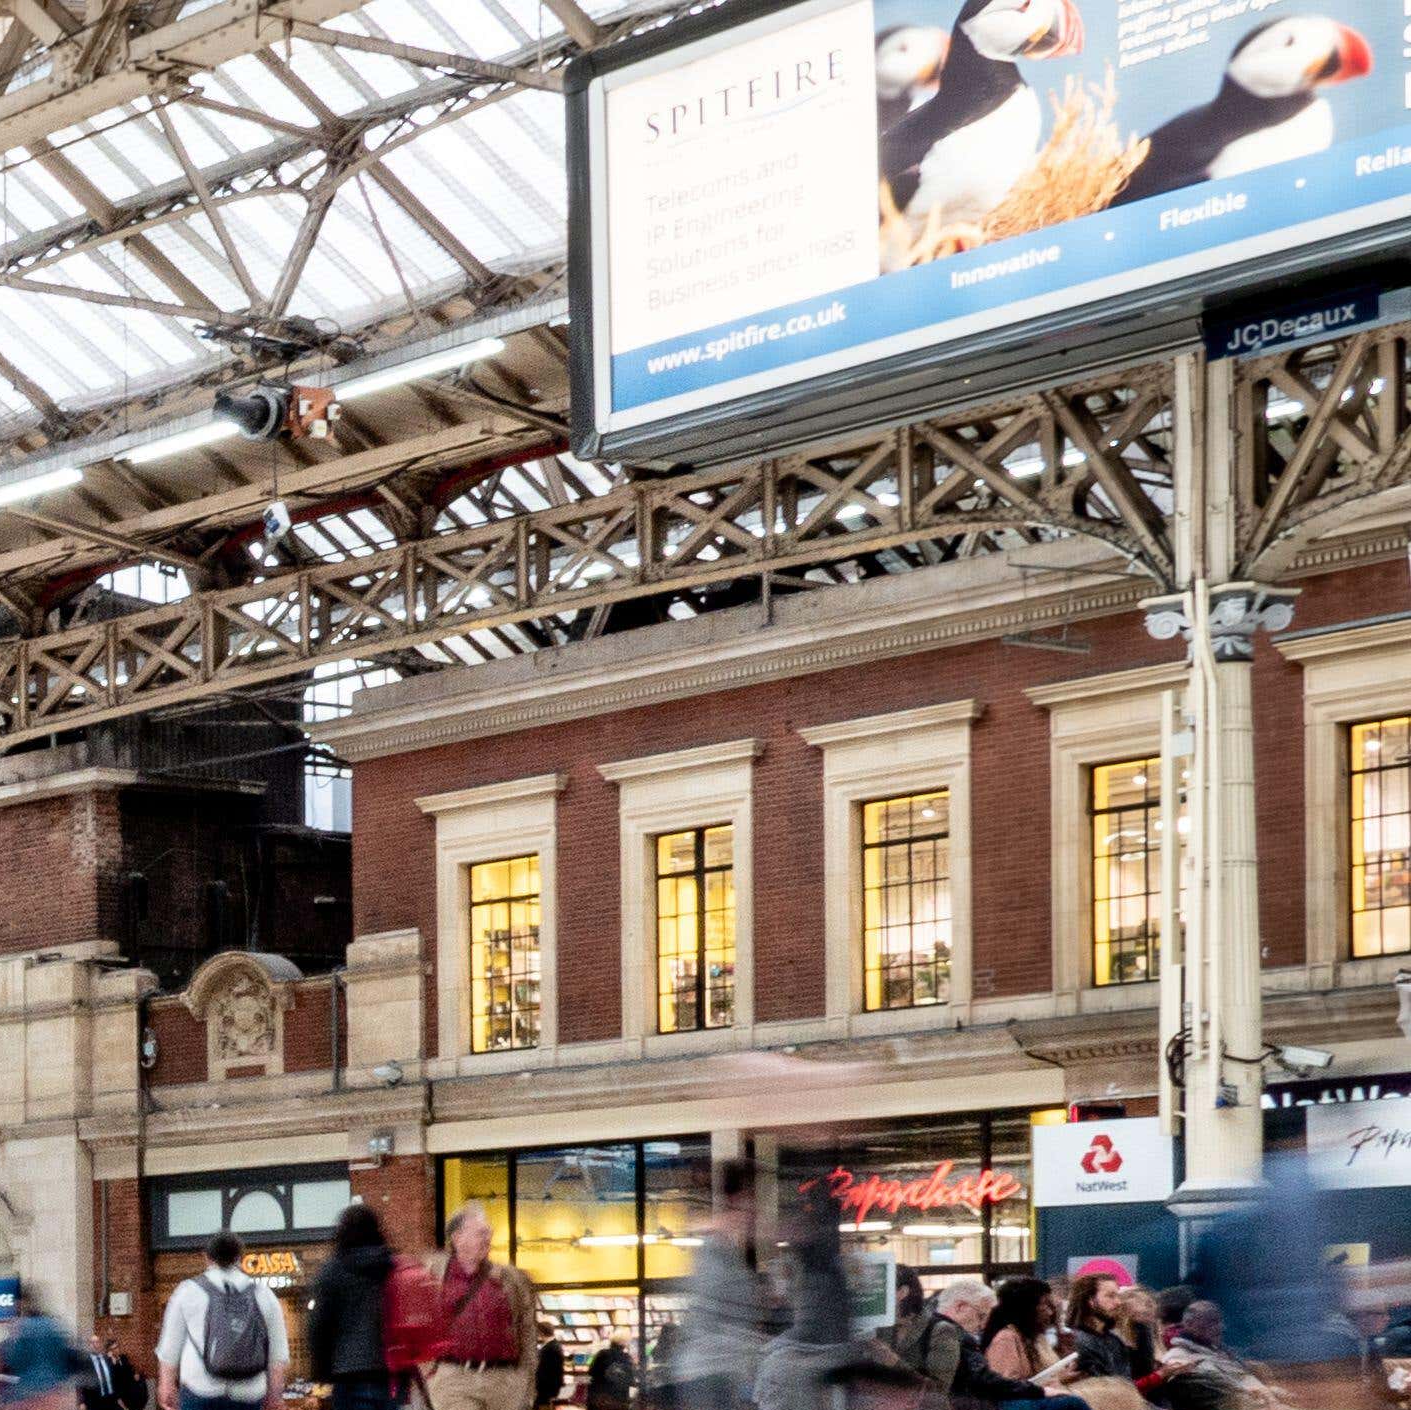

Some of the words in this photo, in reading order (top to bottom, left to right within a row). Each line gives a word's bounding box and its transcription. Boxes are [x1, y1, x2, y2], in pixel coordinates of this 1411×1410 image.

[645, 48, 844, 145] SPITFIRE
[951, 244, 1062, 290] Innovative
[1159, 191, 1248, 232] Flexible
[648, 269, 739, 312] Business
[646, 302, 847, 375] www.spitfire.co.uk
[1227, 303, 1356, 350] JCDecaux
[1075, 1179, 1129, 1194] NatWest
[241, 1252, 297, 1274] CASA
